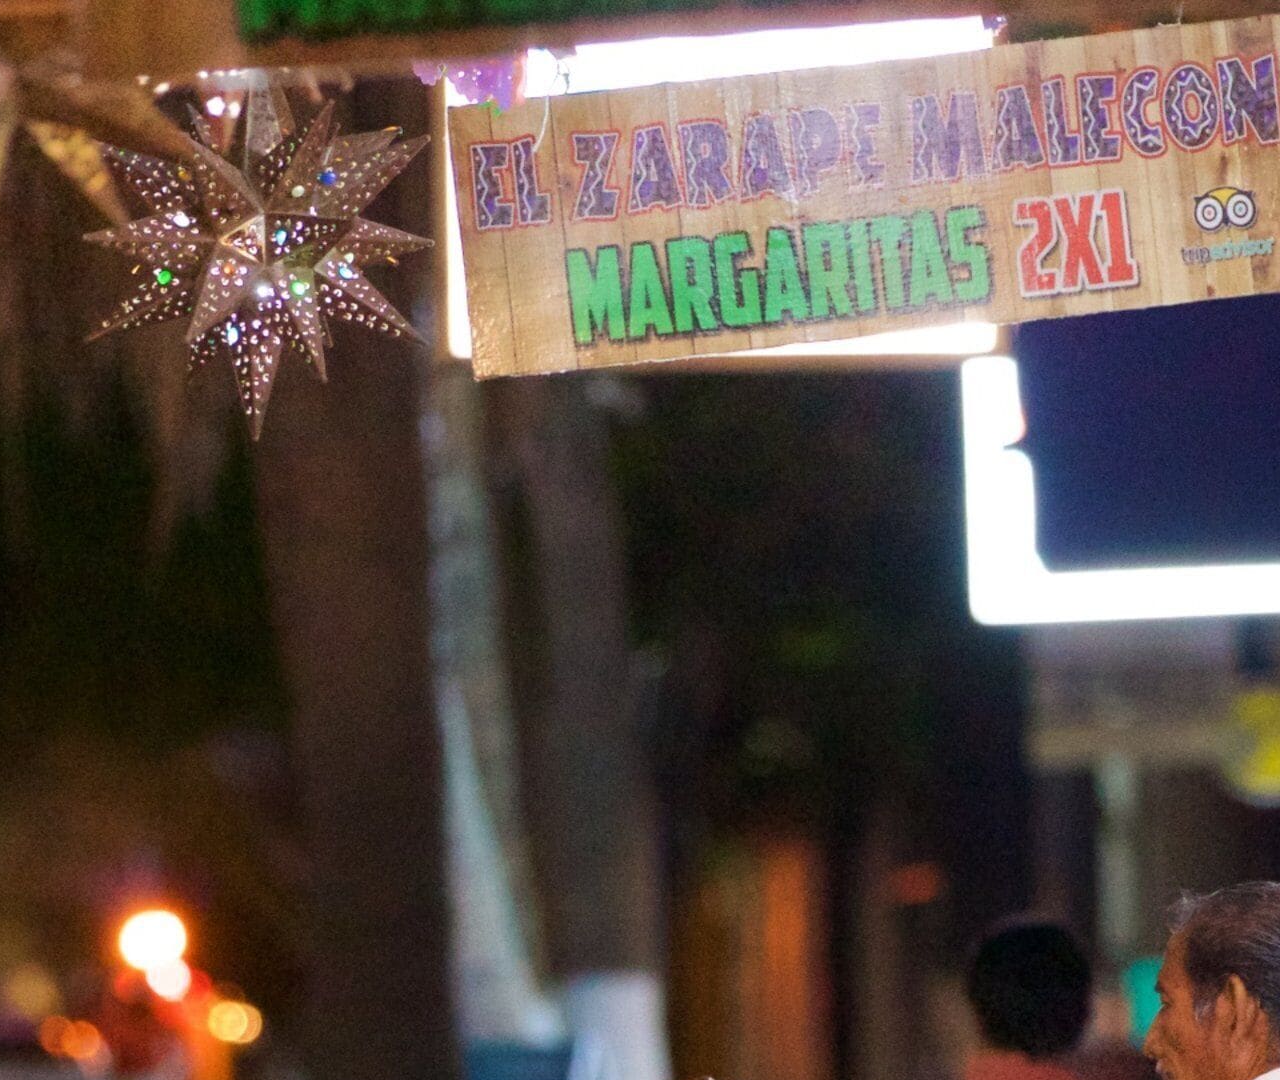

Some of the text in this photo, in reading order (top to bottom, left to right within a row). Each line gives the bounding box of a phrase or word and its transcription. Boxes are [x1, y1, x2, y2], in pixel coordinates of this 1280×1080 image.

[469, 133, 552, 231] EL
[570, 102, 887, 222] ZARAPE
[565, 188, 1139, 346] MARGARITAS 2X1
